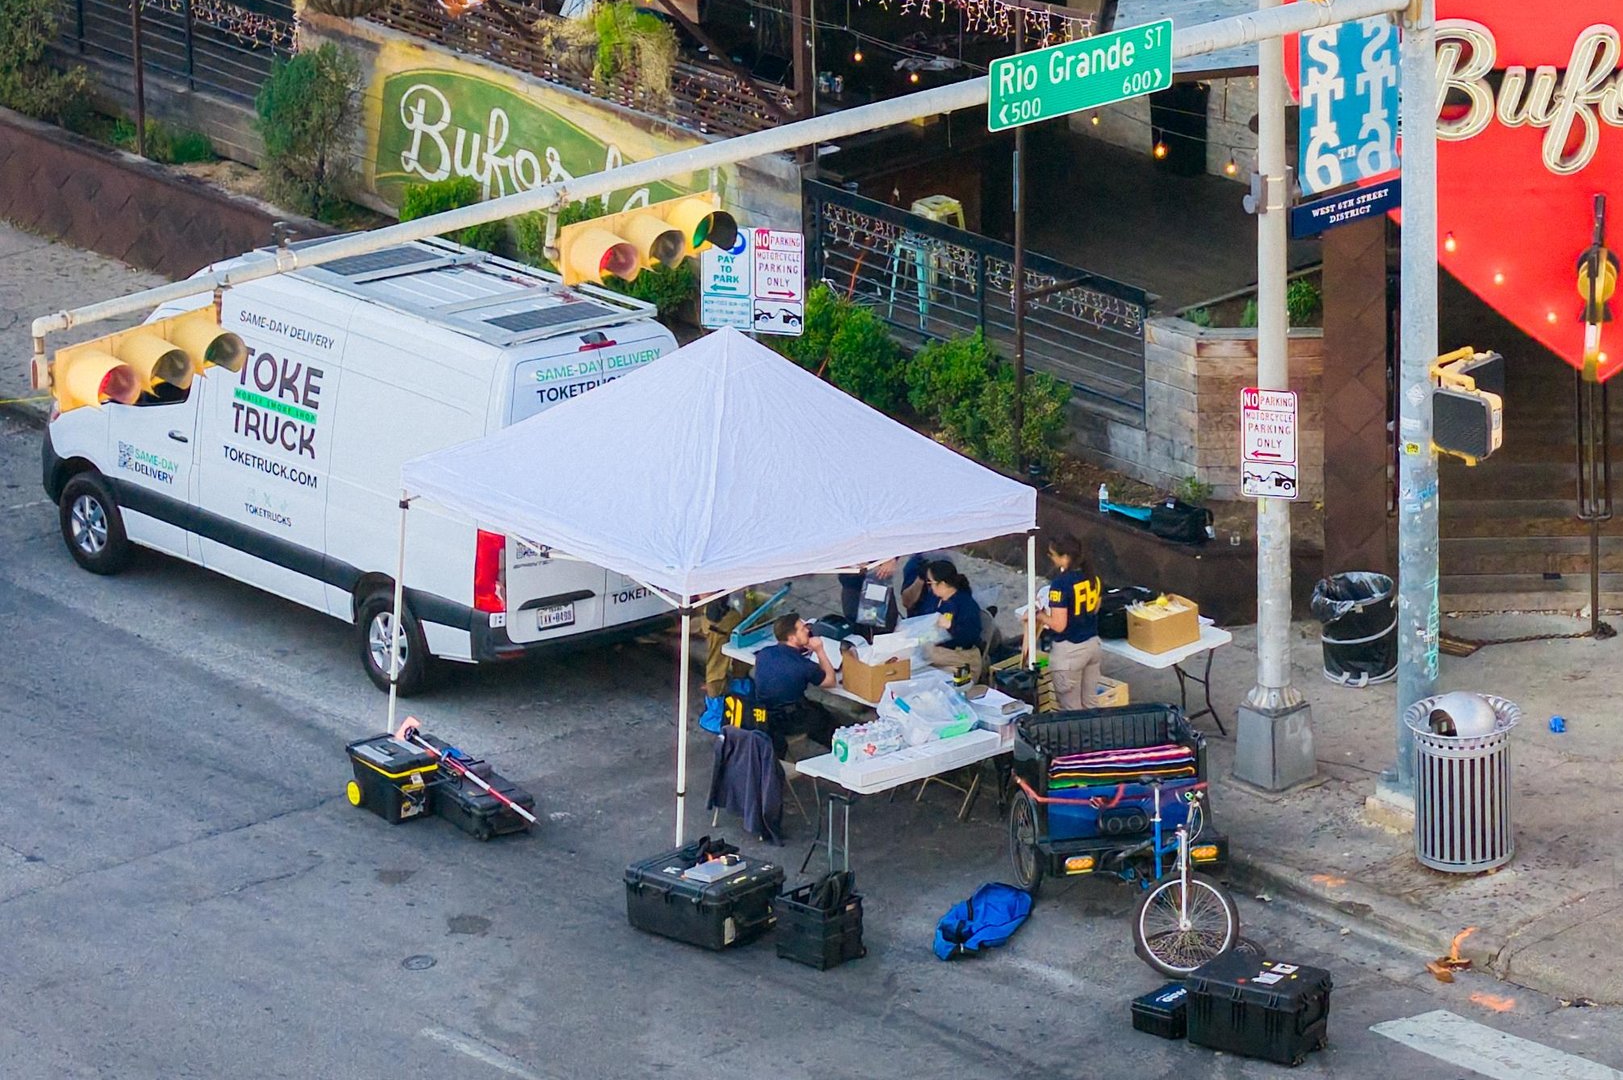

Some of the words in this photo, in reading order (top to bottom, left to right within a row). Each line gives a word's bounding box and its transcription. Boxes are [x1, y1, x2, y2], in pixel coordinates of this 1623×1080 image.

[1000, 60, 1038, 97] Rio
[1049, 37, 1135, 85] Grande
[1144, 26, 1164, 50] ST
[1011, 97, 1041, 121] 500
[1122, 71, 1152, 95] 600
[1312, 205, 1336, 218] WEST
[1338, 199, 1355, 210] 6TH
[1356, 188, 1389, 204] STREET
[1329, 205, 1371, 224] DISTRICT
[756, 232, 769, 247] NO
[770, 237, 800, 247] PARKING
[717, 255, 736, 263] PAY
[757, 252, 800, 263] MOTORCYCLE
[720, 265, 732, 273] TO
[759, 263, 798, 274] PARKING
[713, 274, 739, 284] PARK
[767, 277, 790, 287] ONLY
[240, 310, 290, 335] SAME-DAY
[290, 325, 334, 350] DELIVERY
[536, 359, 604, 383] SAME-DAY
[608, 348, 661, 369] DELIVERY
[240, 345, 324, 410] TOKE
[1244, 392, 1259, 407] NO
[1260, 396, 1293, 407] PARKING
[1246, 411, 1292, 423] MOTORCYCLE
[232, 401, 316, 460] TRUCK
[1248, 423, 1291, 435] PARKING
[1257, 438, 1282, 449] ONLY
[135, 448, 179, 473] SAME-DAY
[223, 445, 318, 489] TOKETRUCK.COM
[134, 461, 174, 485] DELIVERY
